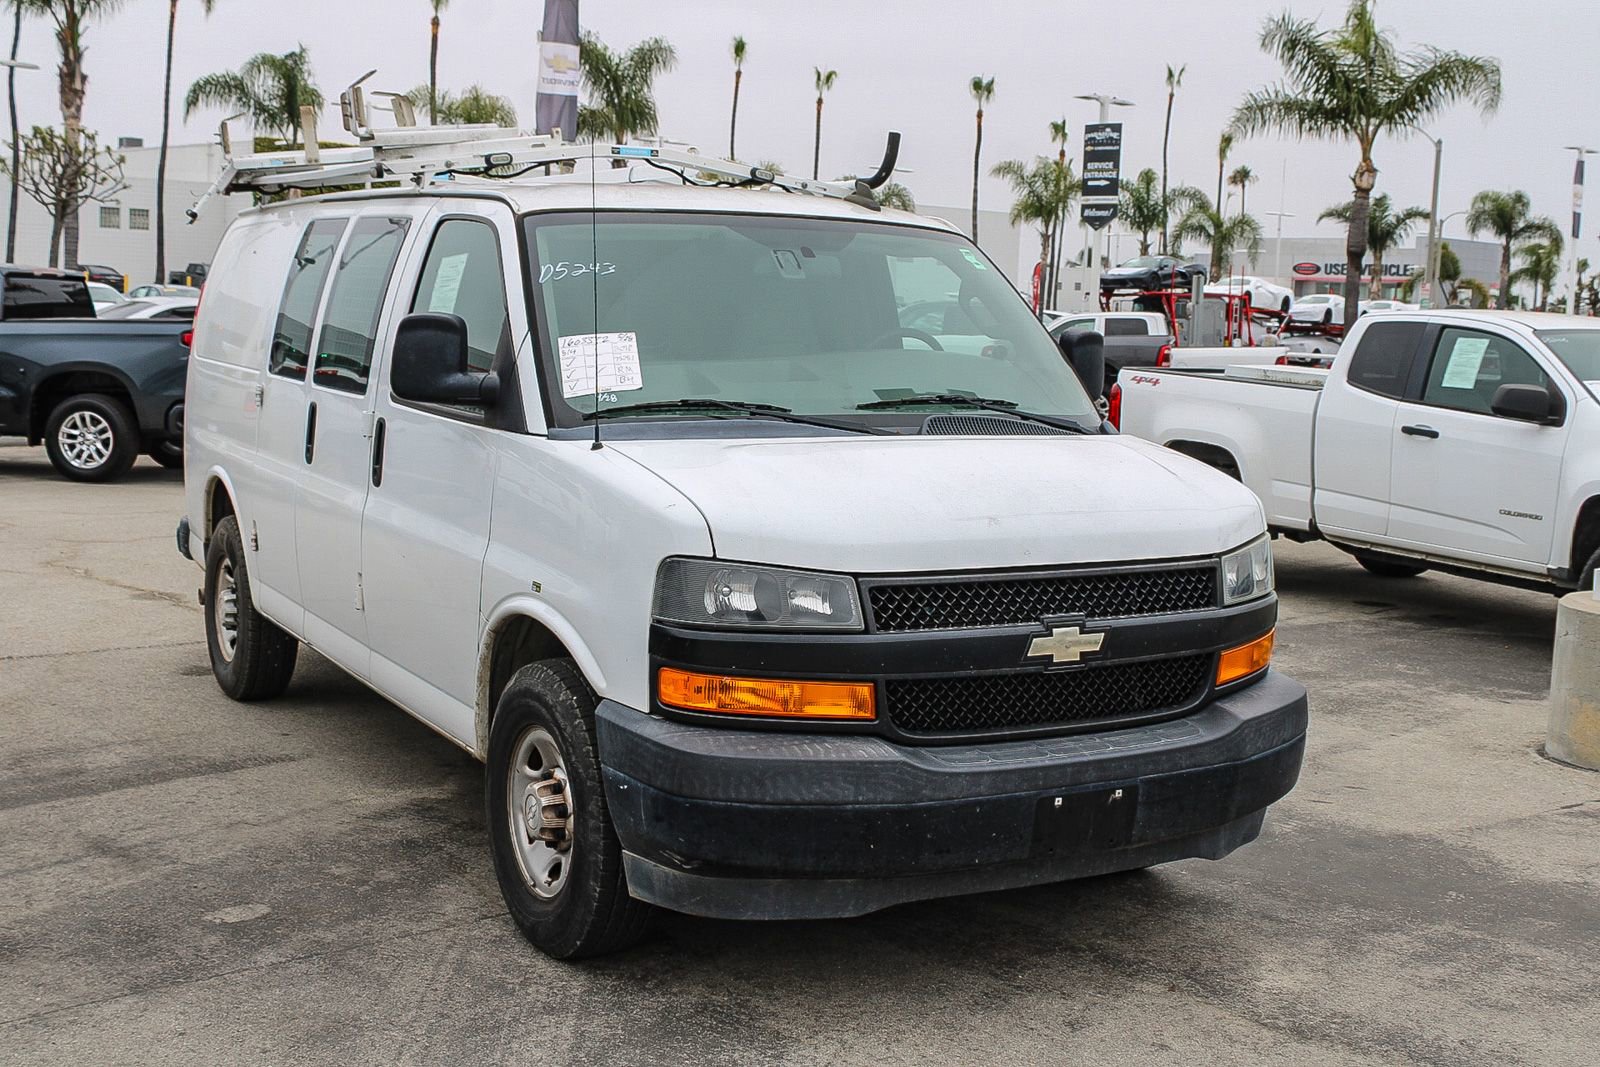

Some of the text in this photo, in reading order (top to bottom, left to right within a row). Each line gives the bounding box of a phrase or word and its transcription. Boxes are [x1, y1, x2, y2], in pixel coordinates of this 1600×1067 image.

[1087, 162, 1114, 170] SERVICE
[539, 261, 616, 284] D5243
[1324, 263, 1349, 276] USE
[1499, 509, 1543, 520] COLORADO
